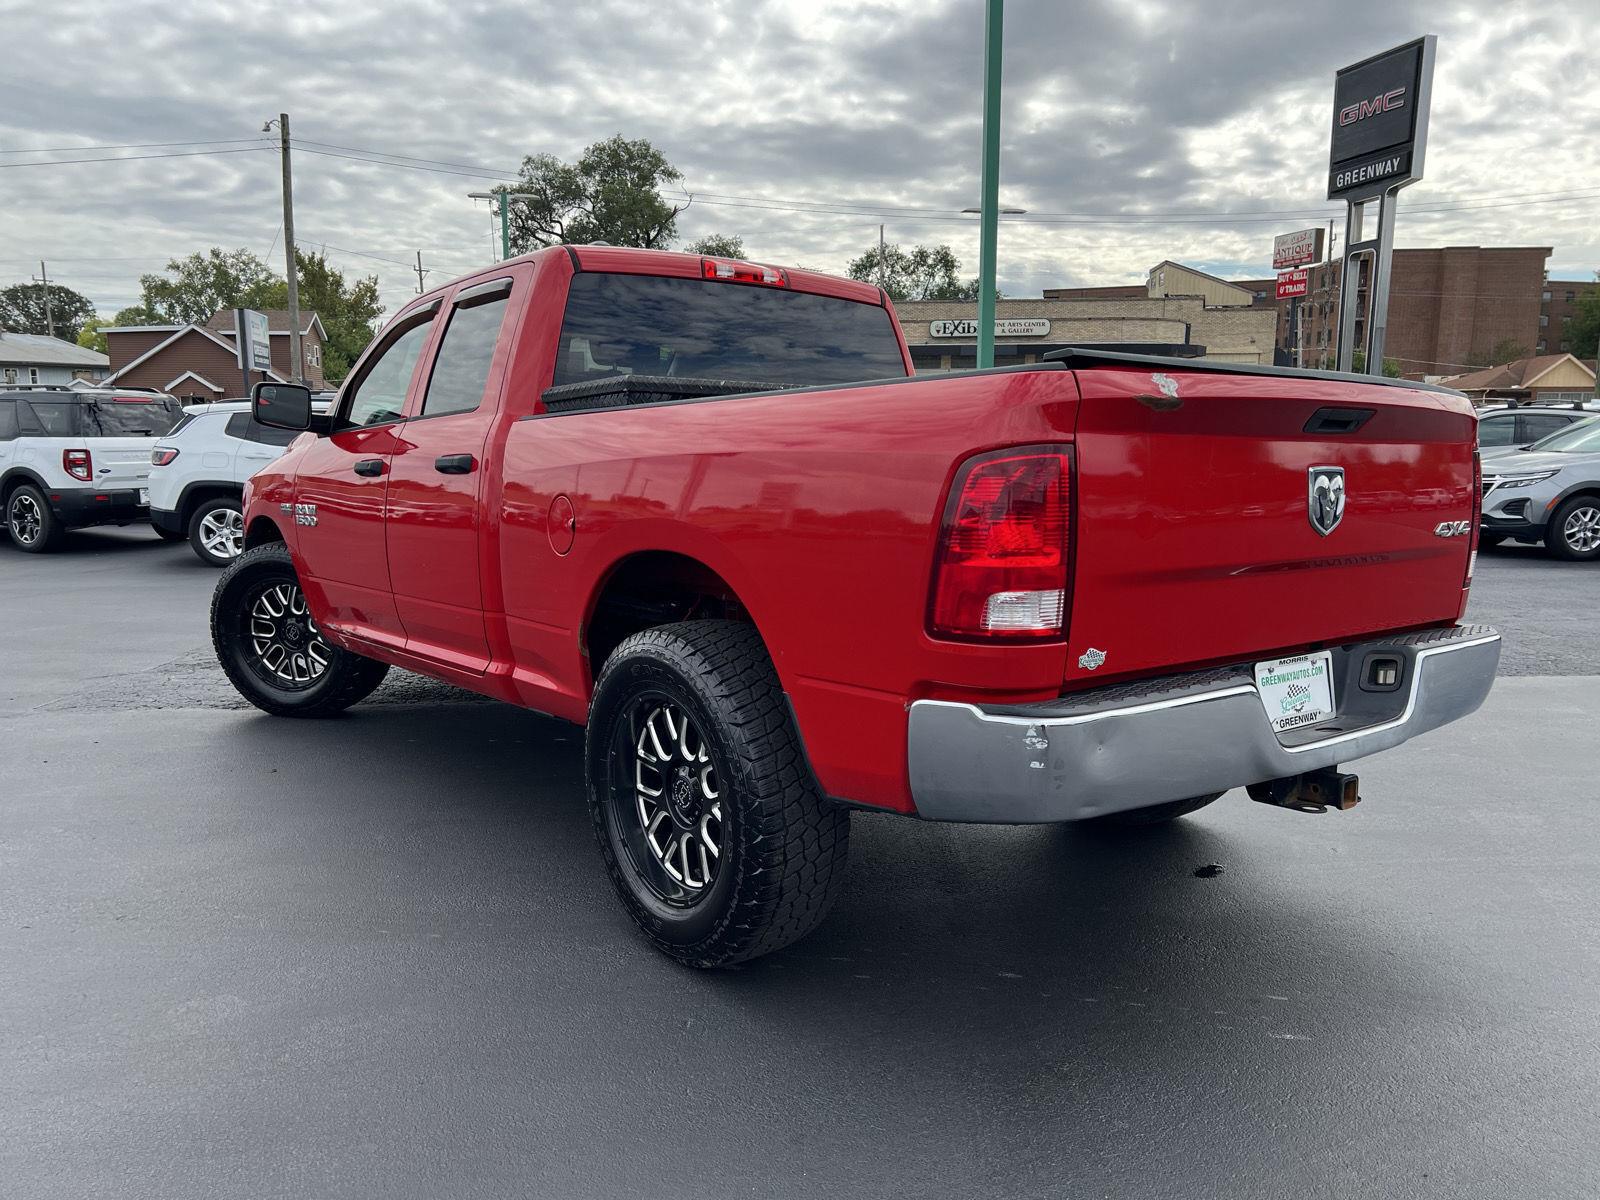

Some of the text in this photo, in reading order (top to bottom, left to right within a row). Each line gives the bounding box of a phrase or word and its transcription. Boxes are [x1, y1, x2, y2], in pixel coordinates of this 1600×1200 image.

[1340, 87, 1406, 127] GMC
[1336, 157, 1400, 188] GREENWAY
[1276, 243, 1312, 258] ANTIQUE
[1278, 271, 1307, 283] BUY SELL
[1285, 284, 1305, 292] TRADE
[296, 515, 317, 526] 1500
[1279, 656, 1308, 665] MORRIS
[1261, 666, 1323, 687] GREENWAYAUTOS.COM
[1280, 712, 1317, 728] GREENWAY
